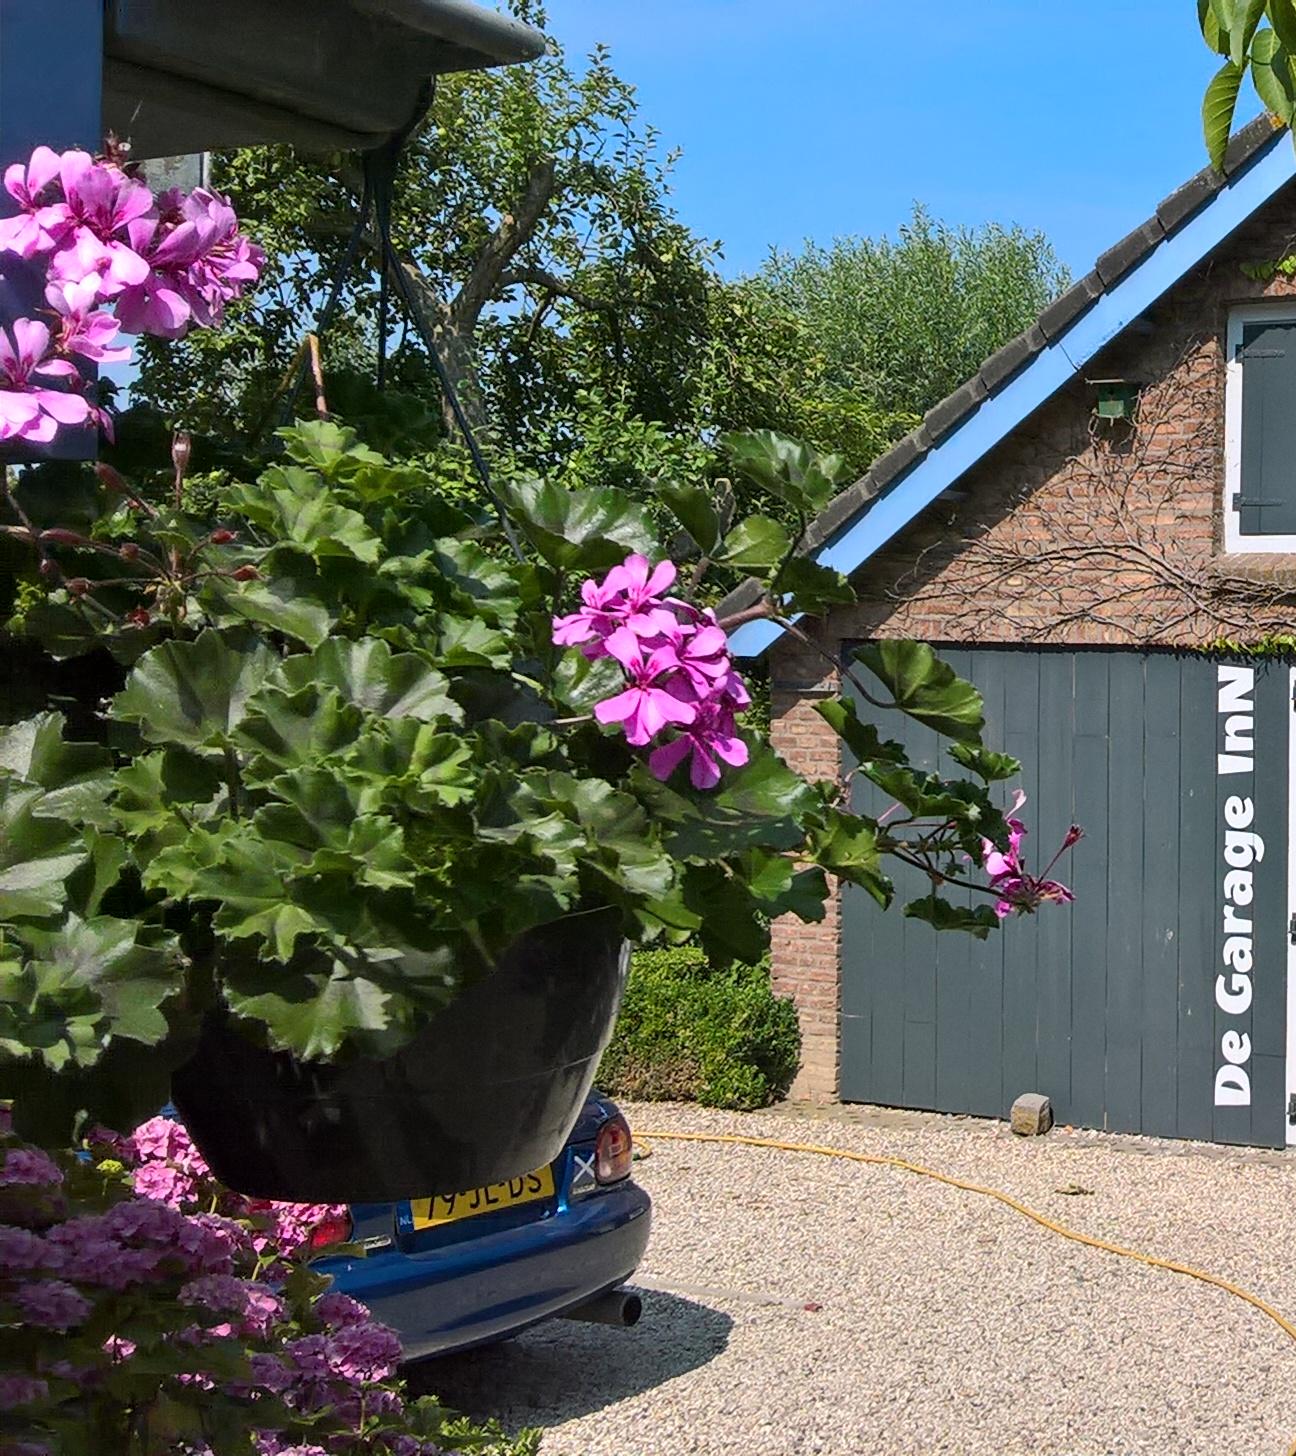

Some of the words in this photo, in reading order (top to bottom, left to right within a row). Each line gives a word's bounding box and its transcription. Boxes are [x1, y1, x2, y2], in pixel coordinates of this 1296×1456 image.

[1217, 664, 1255, 775] InN
[1215, 795, 1265, 1015] Garage
[1214, 1030, 1252, 1106] De
